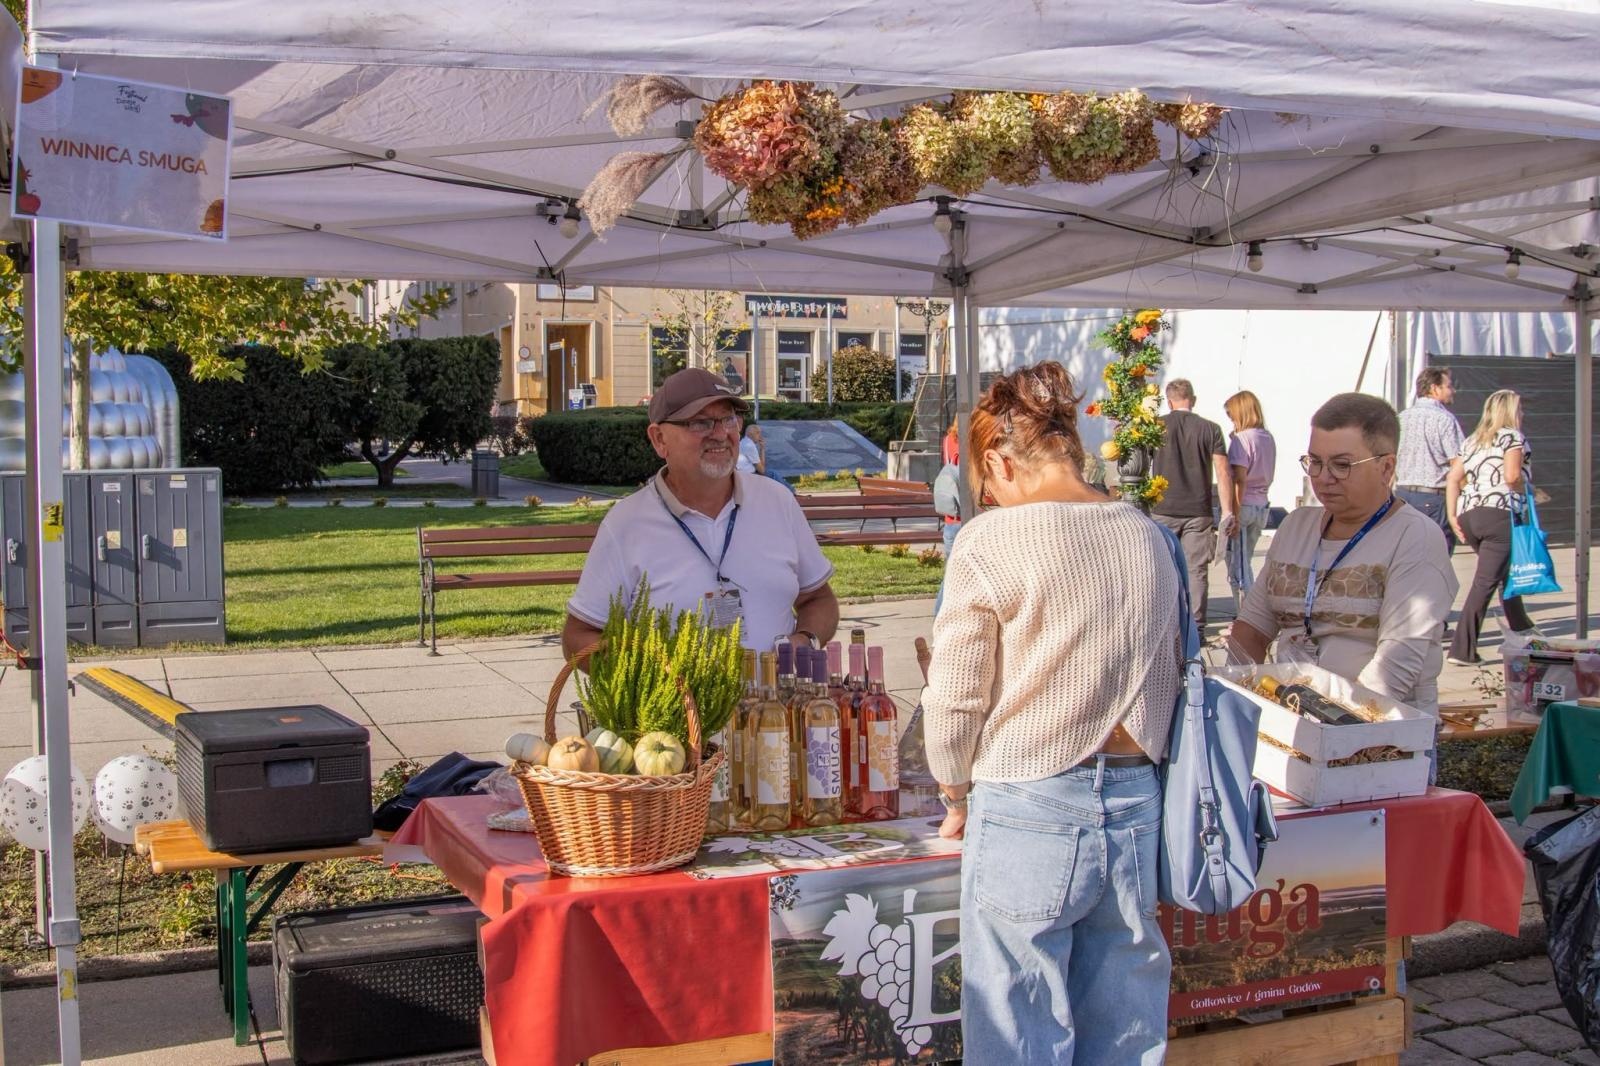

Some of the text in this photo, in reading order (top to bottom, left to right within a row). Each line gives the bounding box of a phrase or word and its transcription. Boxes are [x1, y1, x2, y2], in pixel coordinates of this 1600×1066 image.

[40, 137, 208, 175] WINNICA SMUGA
[1545, 684, 1562, 696] 32
[830, 728, 841, 795] SMUGA
[1254, 987, 1285, 1002] gmina
[1288, 982, 1323, 994] Godów
